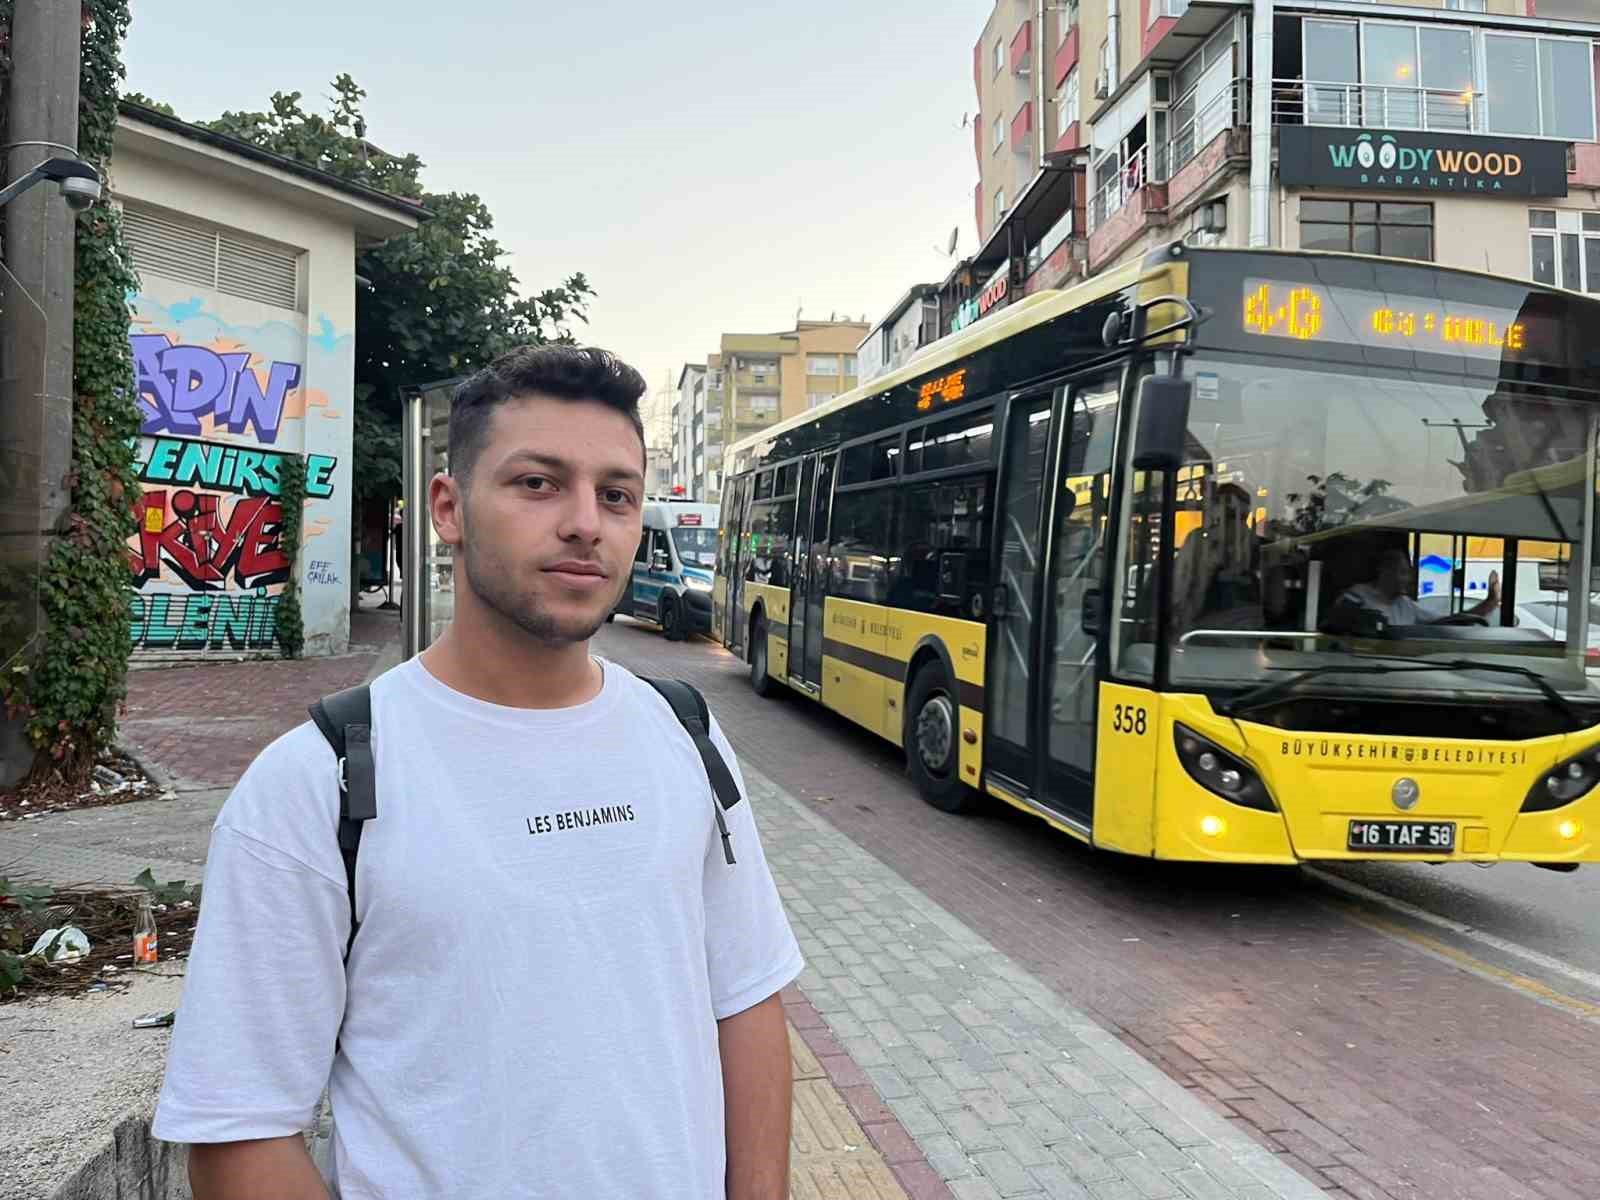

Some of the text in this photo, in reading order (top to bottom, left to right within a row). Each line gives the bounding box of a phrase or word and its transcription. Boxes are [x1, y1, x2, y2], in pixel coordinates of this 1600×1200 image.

[130, 334, 300, 443] ADIN
[1113, 703, 1147, 736] 358
[1281, 739, 1527, 765] BÜYÜKŞEHİR BELEDİYESİ
[526, 804, 635, 835] LES BENJAMINS
[1361, 824, 1380, 845] 16
[1386, 825, 1425, 845] TAF
